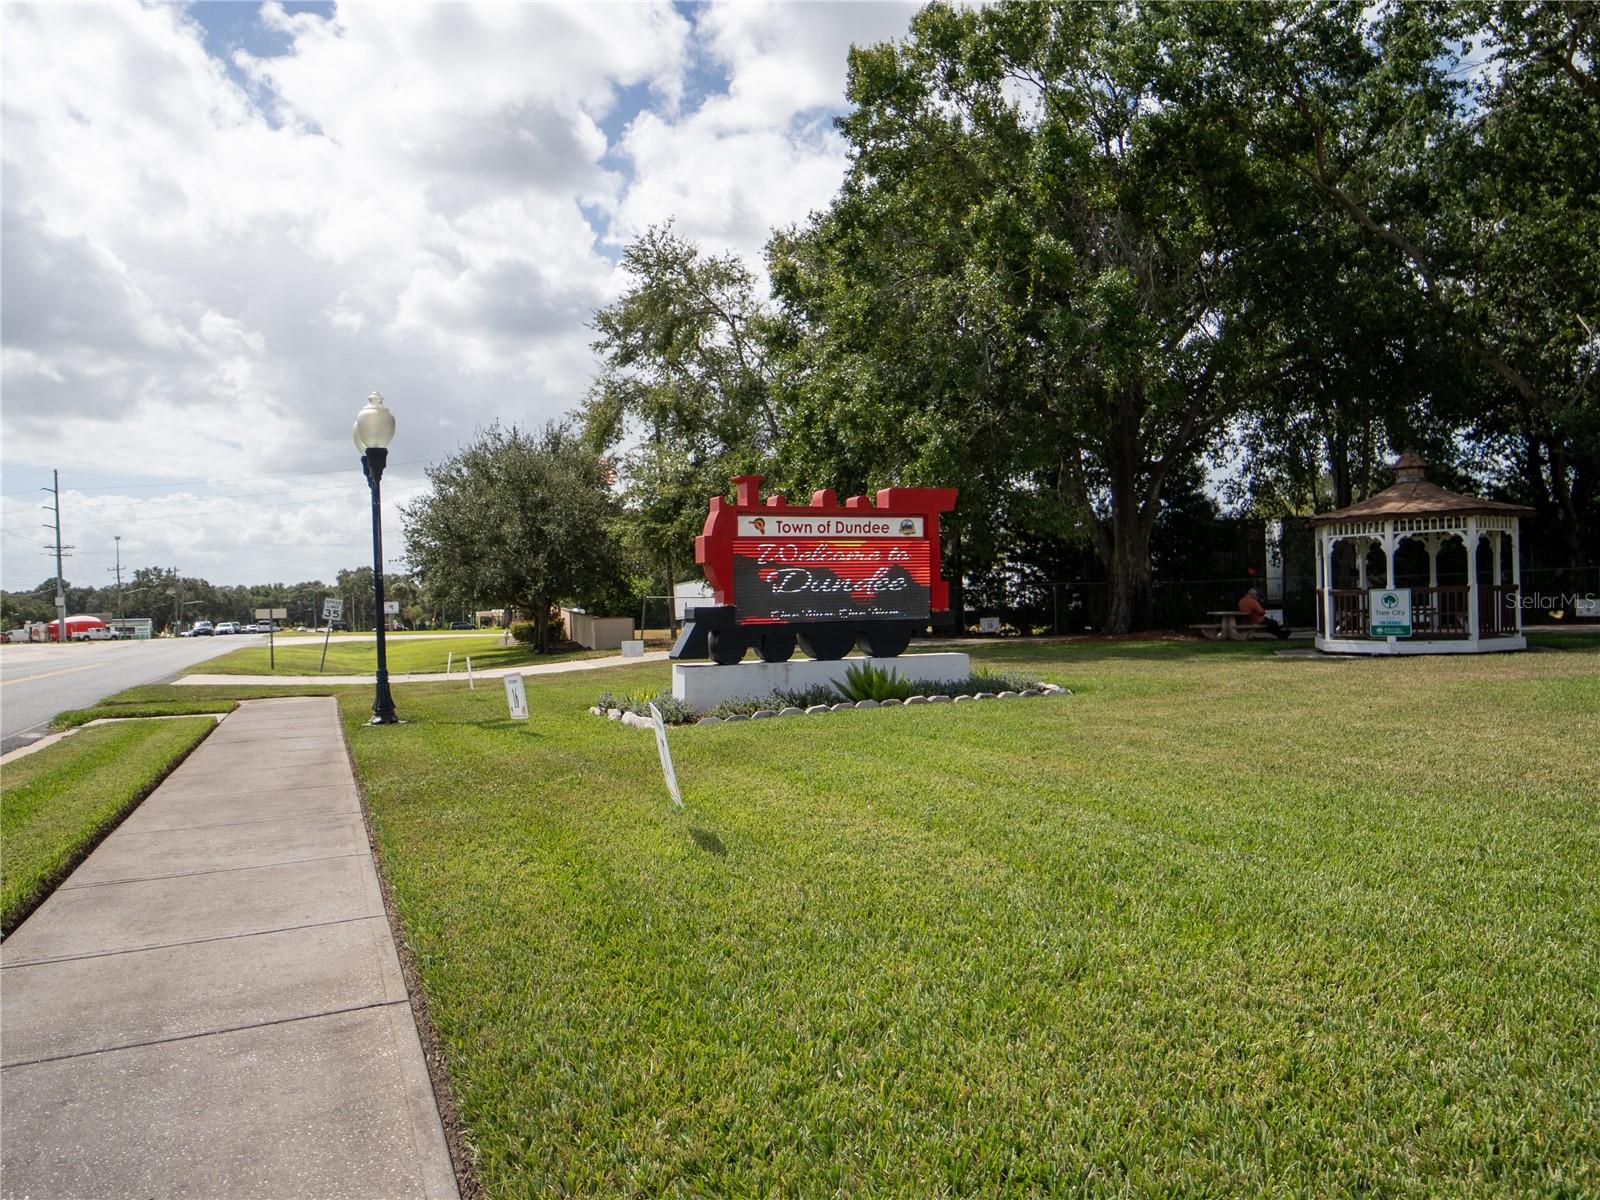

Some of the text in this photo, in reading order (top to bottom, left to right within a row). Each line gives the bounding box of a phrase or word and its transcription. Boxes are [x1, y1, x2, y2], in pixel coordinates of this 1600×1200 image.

[776, 520, 890, 534] Town of Dundee
[757, 544, 912, 565] Welcome to
[766, 567, 908, 595] Dundee
[324, 609, 340, 618] 35
[1391, 609, 1406, 617] City
